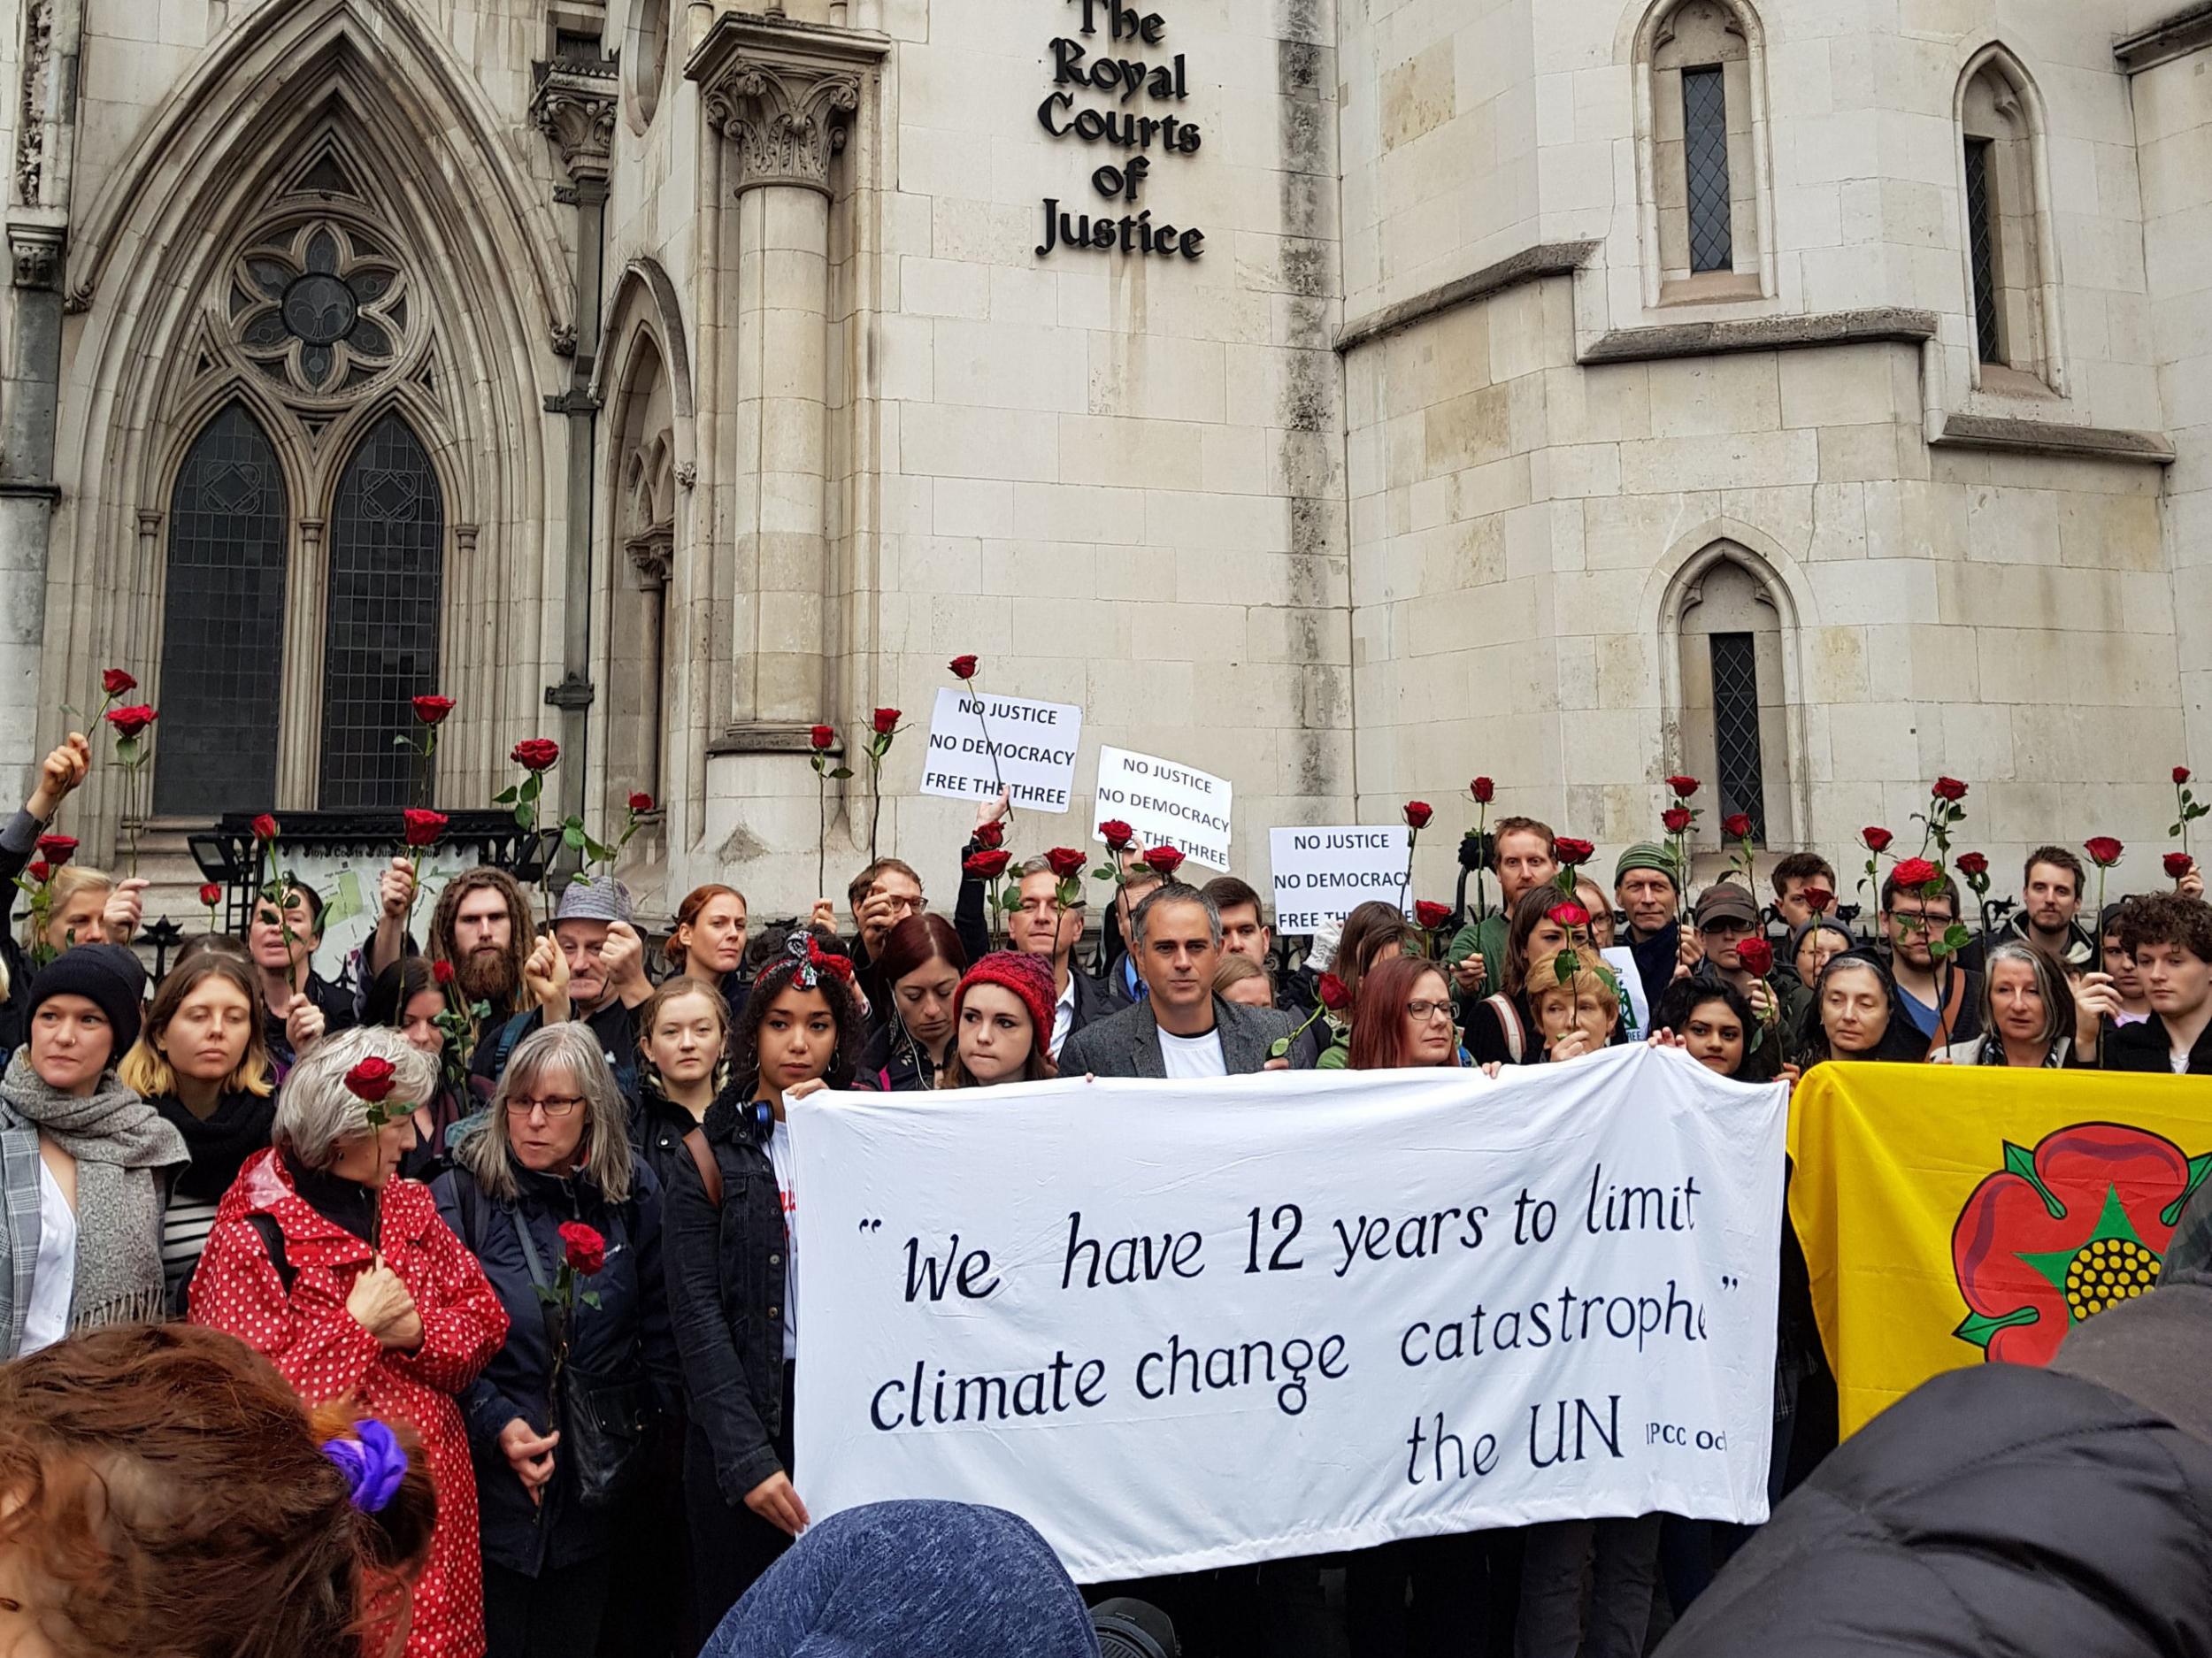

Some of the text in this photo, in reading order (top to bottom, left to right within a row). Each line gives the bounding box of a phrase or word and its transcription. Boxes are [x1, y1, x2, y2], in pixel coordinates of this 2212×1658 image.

[1067, 0, 1166, 44] The
[1048, 37, 1189, 104] Royal
[1037, 90, 1202, 153] Courts
[1092, 155, 1150, 200] of
[1034, 197, 1205, 259] Justice
[958, 698, 1057, 725] NO JUSTICE
[929, 733, 1075, 765] NO DEMOCRACY
[926, 772, 1066, 804] FREE THE THREE
[1123, 758, 1211, 794] NO JUSTICE
[1098, 787, 1125, 803] NO
[1130, 794, 1229, 833] DEMOCRACY
[1179, 839, 1226, 866] THREE
[1294, 833, 1389, 849] NO JUSTICE
[1274, 871, 1410, 889] NO DEMOCRACY
[1279, 911, 1352, 927] FREE TH
[1626, 1032, 1640, 1041] REE
[1063, 1212, 1206, 1291] have
[1245, 1204, 1304, 1275] 12
[1333, 1207, 1490, 1278] years
[1515, 1189, 1557, 1247] to
[1587, 1163, 1702, 1235] limit
[872, 1351, 1108, 1432] climate
[1137, 1335, 1350, 1416] change
[1408, 1412, 1497, 1486] the
[1531, 1396, 1624, 1470] UN
[1647, 1423, 1687, 1447] IPCC
